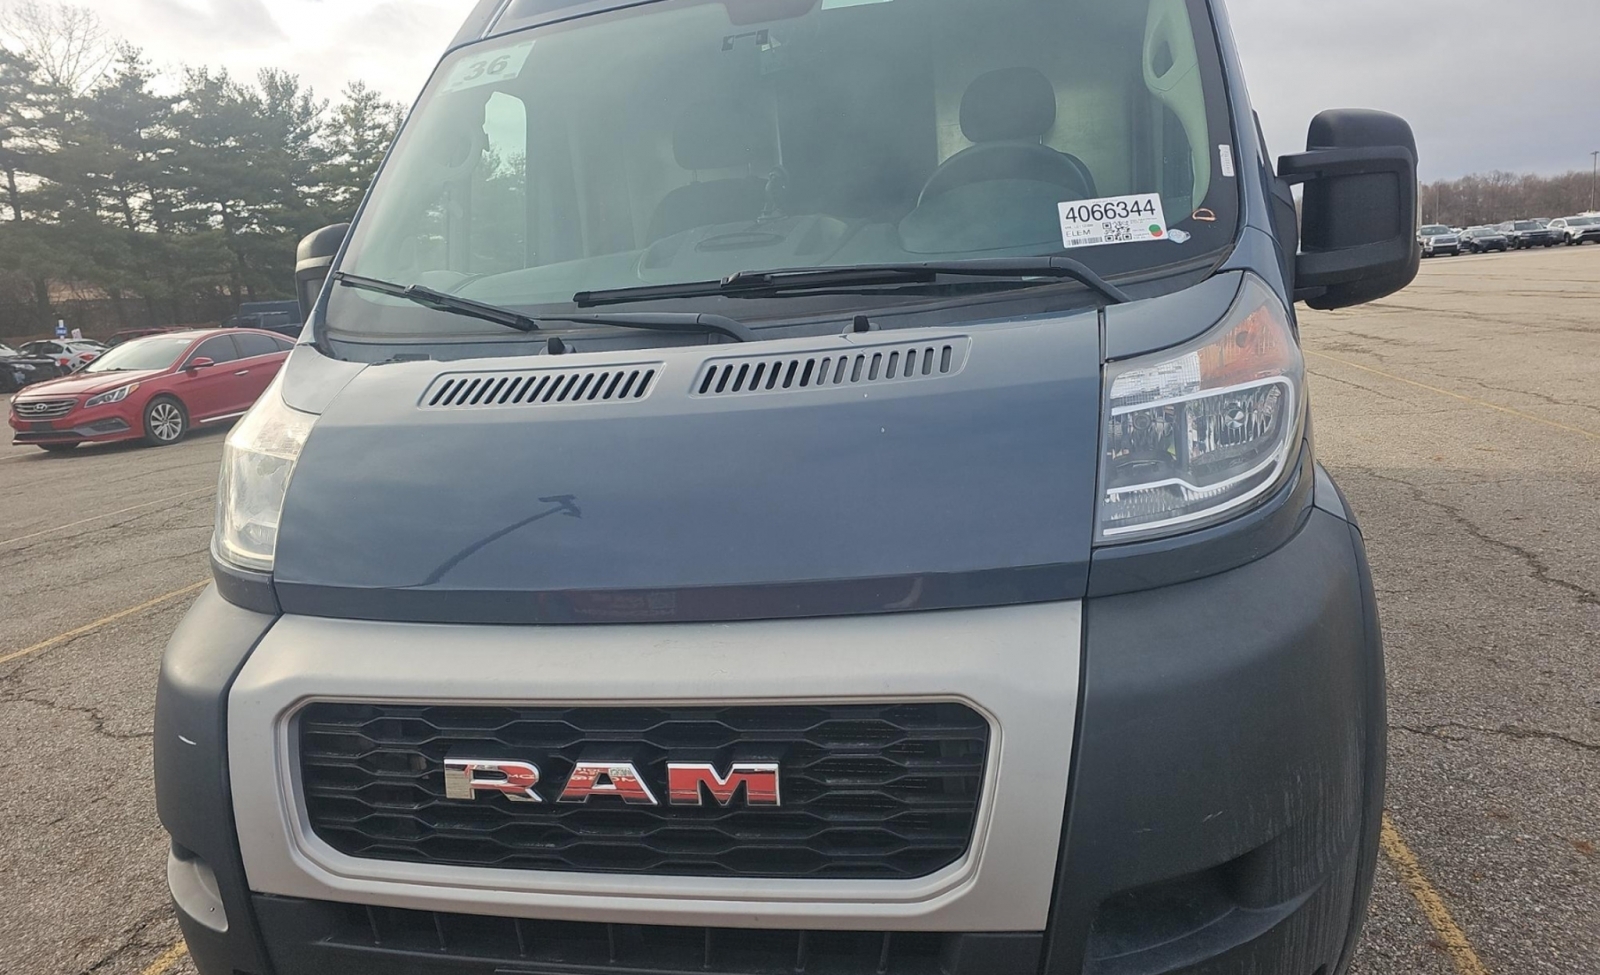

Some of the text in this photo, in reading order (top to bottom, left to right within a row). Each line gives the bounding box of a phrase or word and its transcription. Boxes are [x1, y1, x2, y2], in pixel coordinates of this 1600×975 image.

[463, 54, 511, 81] 36
[1066, 199, 1155, 223] 4066344
[444, 758, 781, 806] RAM
